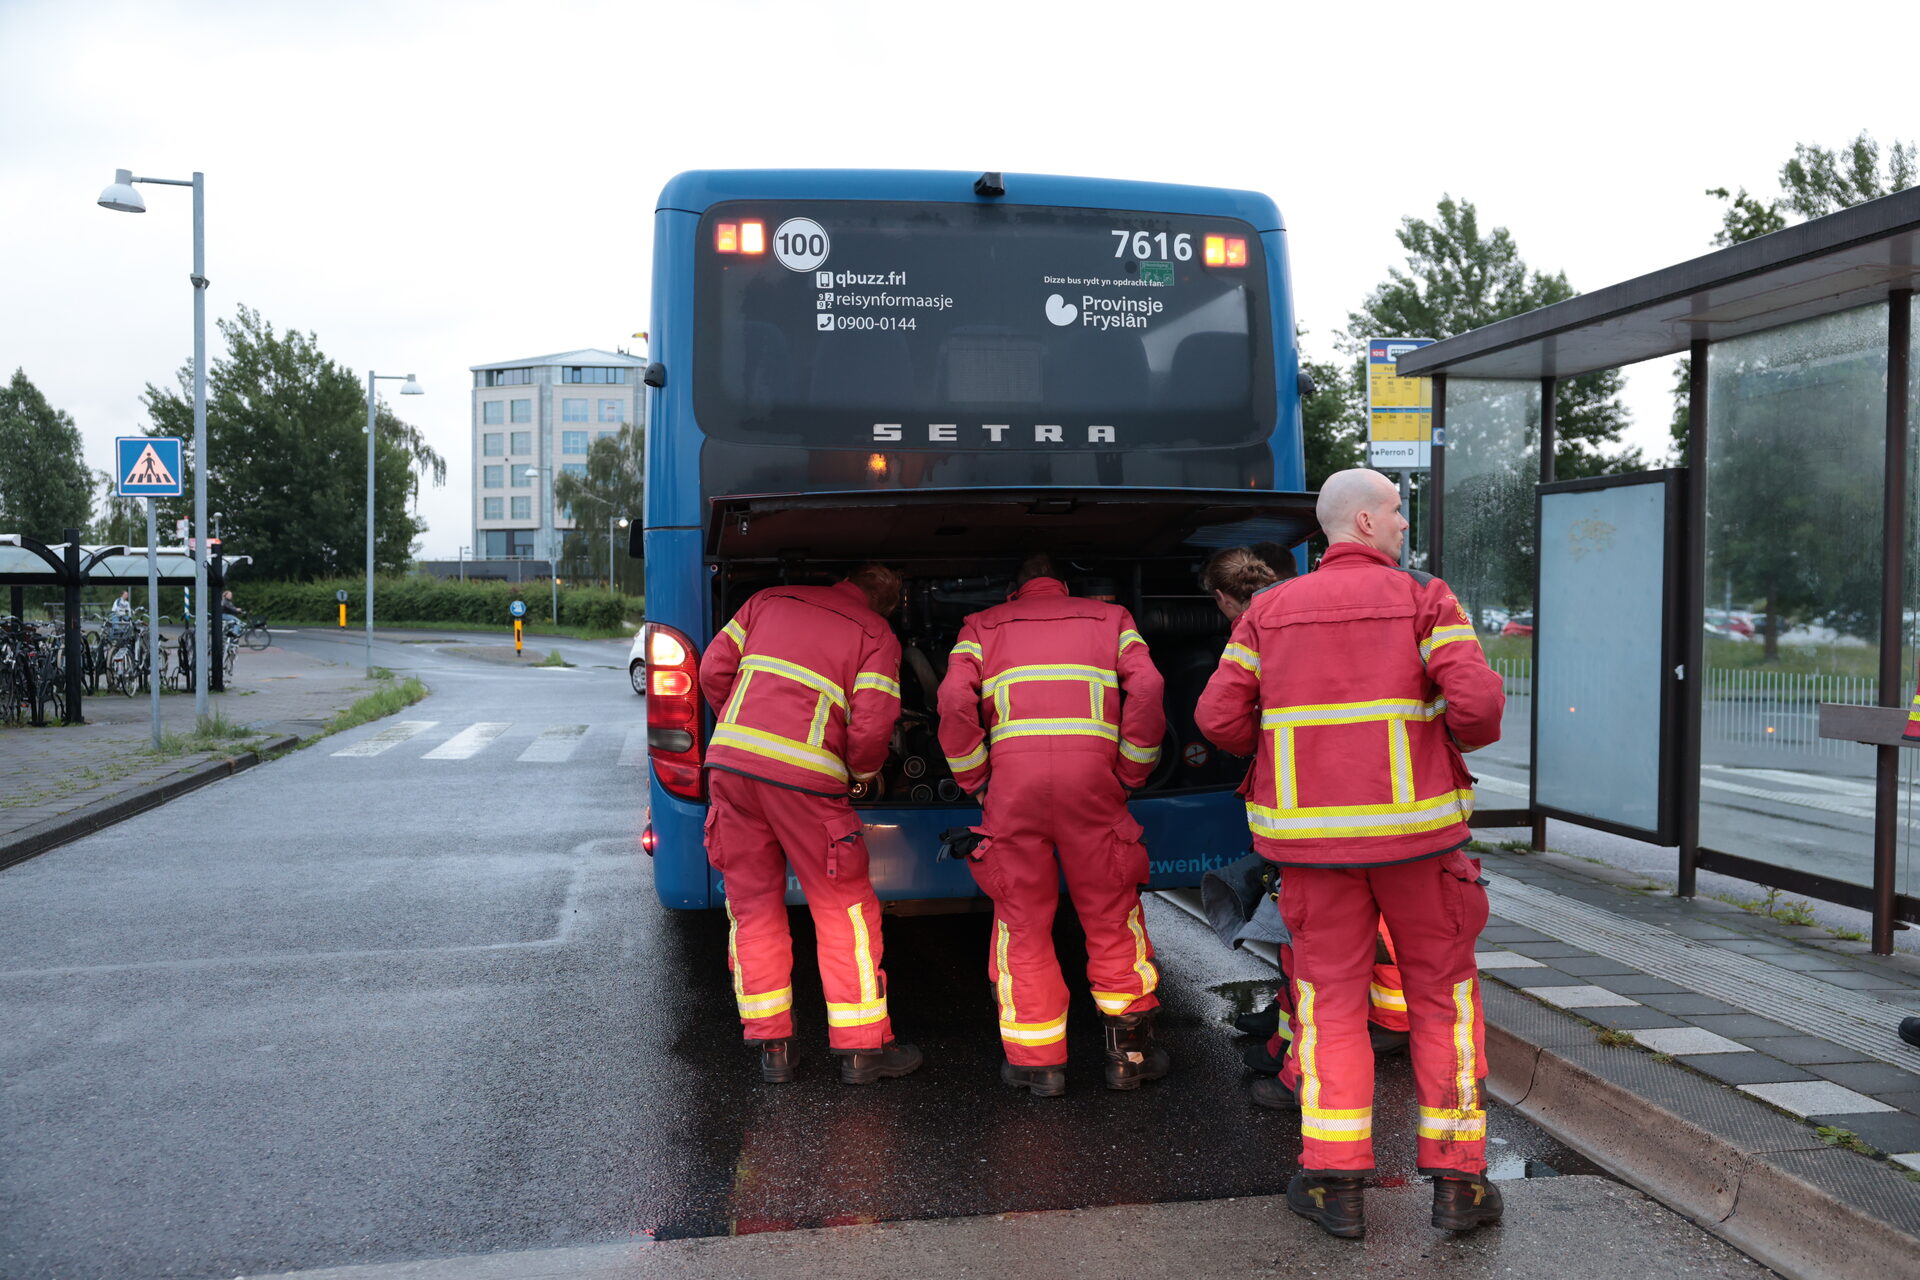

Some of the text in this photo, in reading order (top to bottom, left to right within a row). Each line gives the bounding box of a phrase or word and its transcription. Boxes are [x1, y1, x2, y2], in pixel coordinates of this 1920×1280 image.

[778, 232, 825, 257] 100
[1111, 229, 1193, 261] 7616
[835, 270, 907, 288] qbuzz.frl
[1043, 275, 1165, 288] Dizze bus rydt yn opdracht fan:
[836, 292, 954, 311] reisynformaasje
[1082, 295, 1164, 316] Provinsje
[837, 316, 917, 330] 0900-0144
[1083, 311, 1148, 331] Fryslân
[873, 423, 1116, 443] SETRA
[1380, 448, 1414, 456] Perron D
